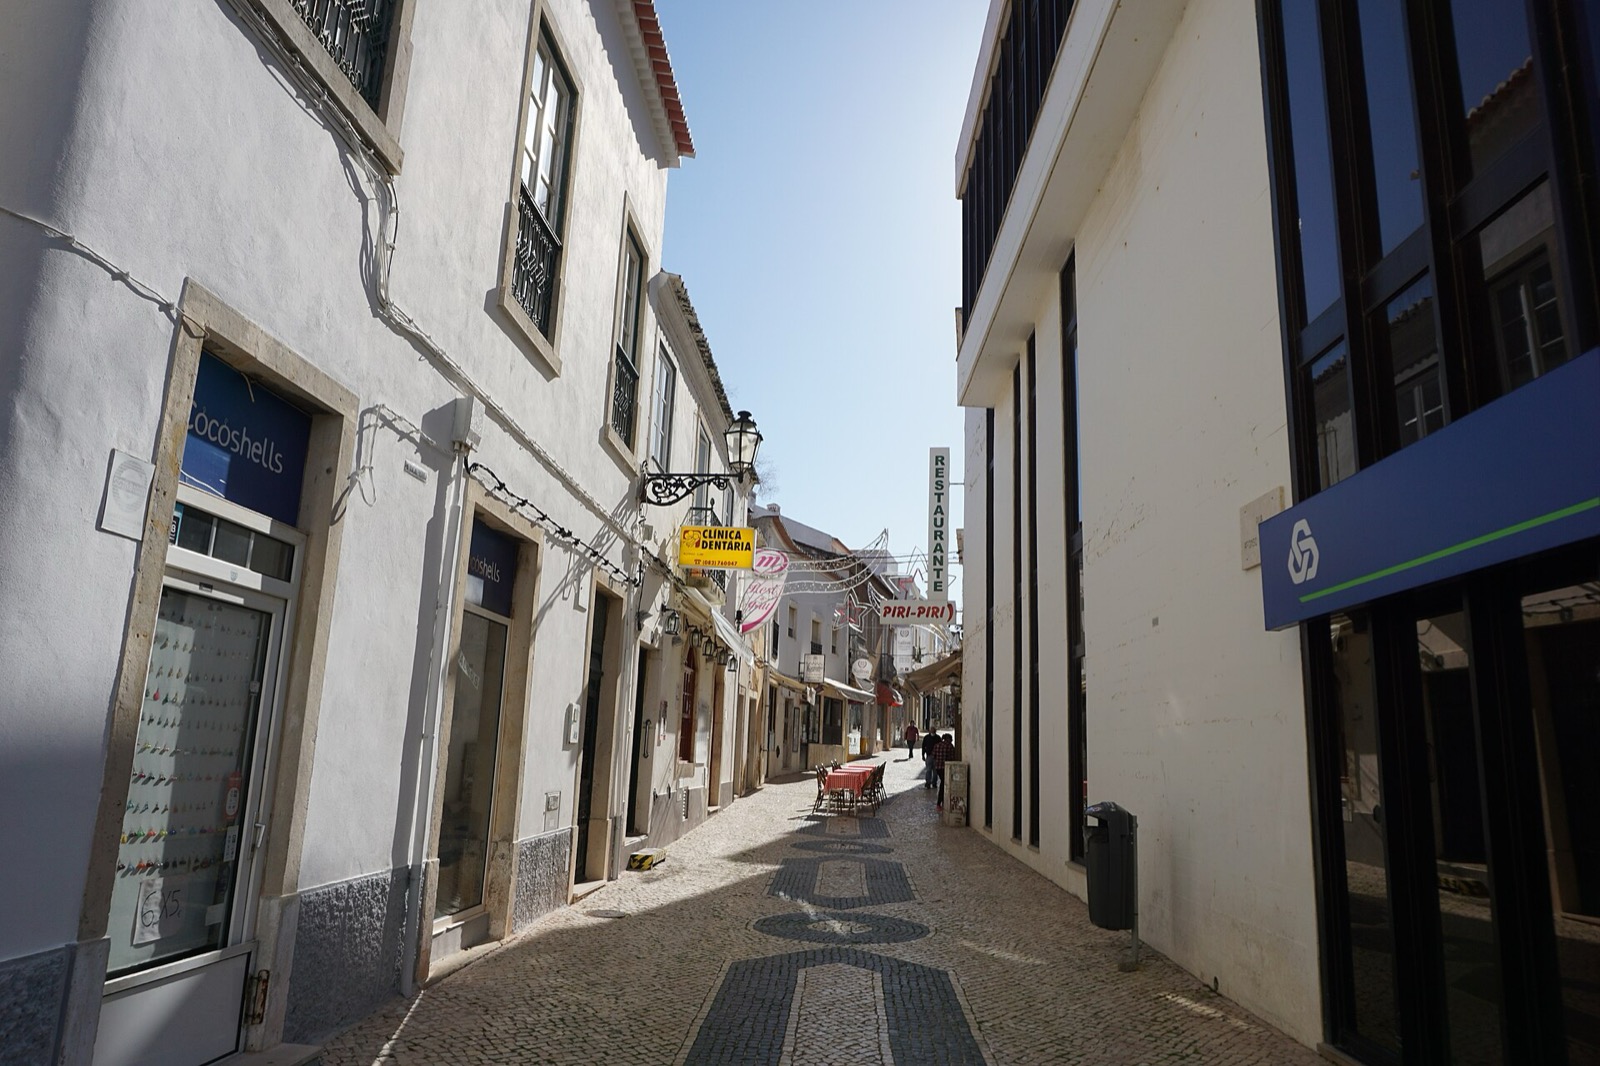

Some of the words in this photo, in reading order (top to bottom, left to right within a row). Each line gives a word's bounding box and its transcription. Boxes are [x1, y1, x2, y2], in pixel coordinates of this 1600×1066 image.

[932, 455, 945, 592] RESTAURANTE
[702, 528, 741, 540] CLÍNICA
[701, 541, 752, 552] DENTÁRIA
[882, 605, 946, 619] PIRI-PIRI
